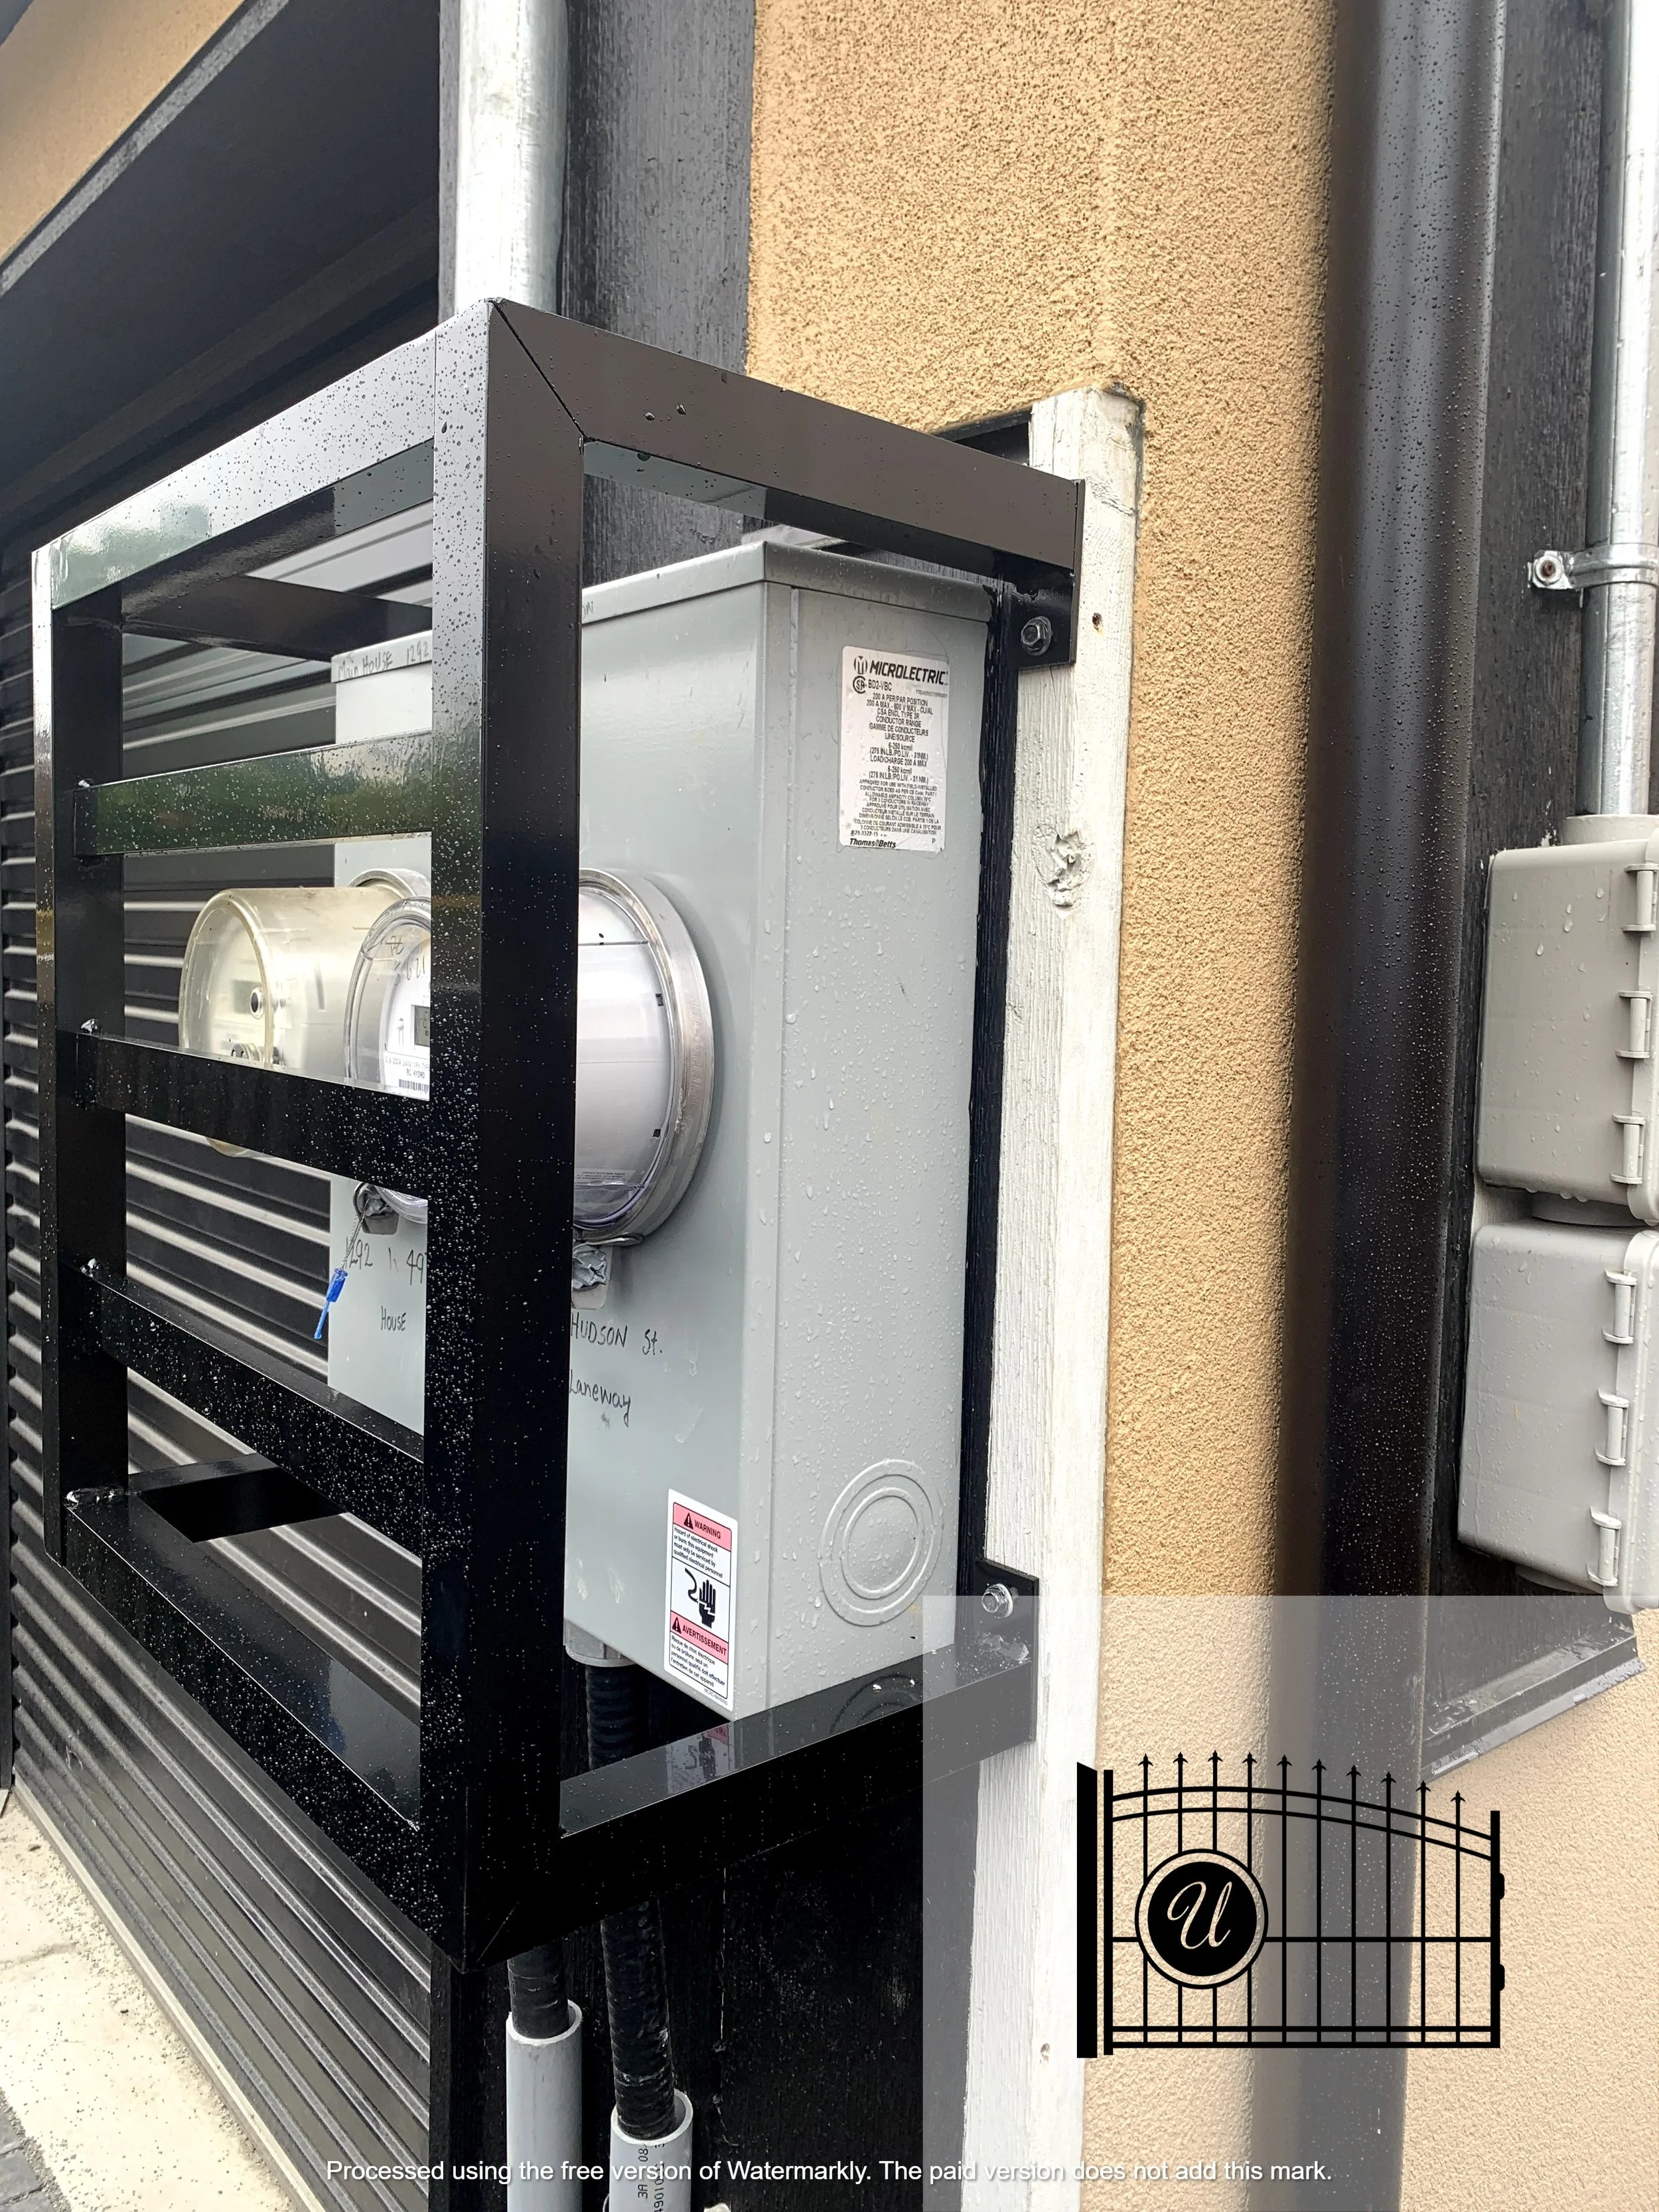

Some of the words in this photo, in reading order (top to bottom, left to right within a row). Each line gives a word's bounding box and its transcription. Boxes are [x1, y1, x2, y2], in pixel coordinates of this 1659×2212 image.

[407, 641, 429, 666] 1292
[869, 660, 946, 686] MICROLECTRIC
[907, 697, 928, 707] POSITION
[876, 715, 904, 725] CONDUCTOR
[906, 719, 921, 728] RANGE
[901, 711, 913, 719] TYPE
[869, 723, 887, 731] GAMME
[895, 726, 928, 737] CONDUCTEURS
[406, 1249, 427, 1286] 49
[571, 1312, 628, 1348] HUDSON
[569, 1368, 631, 1428] Laneway
[694, 1520, 721, 1539] WARNING
[691, 1536, 707, 1547] electrical
[707, 1544, 718, 1553] shock
[695, 1546, 713, 1558] equipment
[674, 1549, 688, 1560] qualified
[689, 1557, 705, 1569] electrical
[705, 1566, 723, 1578] personnel
[696, 1553, 711, 1564] serviced
[682, 1625, 727, 1655] AVERTISSEMENT
[671, 1651, 688, 1664] personnel
[709, 1674, 725, 1686] effectuer
[638, 2142, 648, 2162] 08
